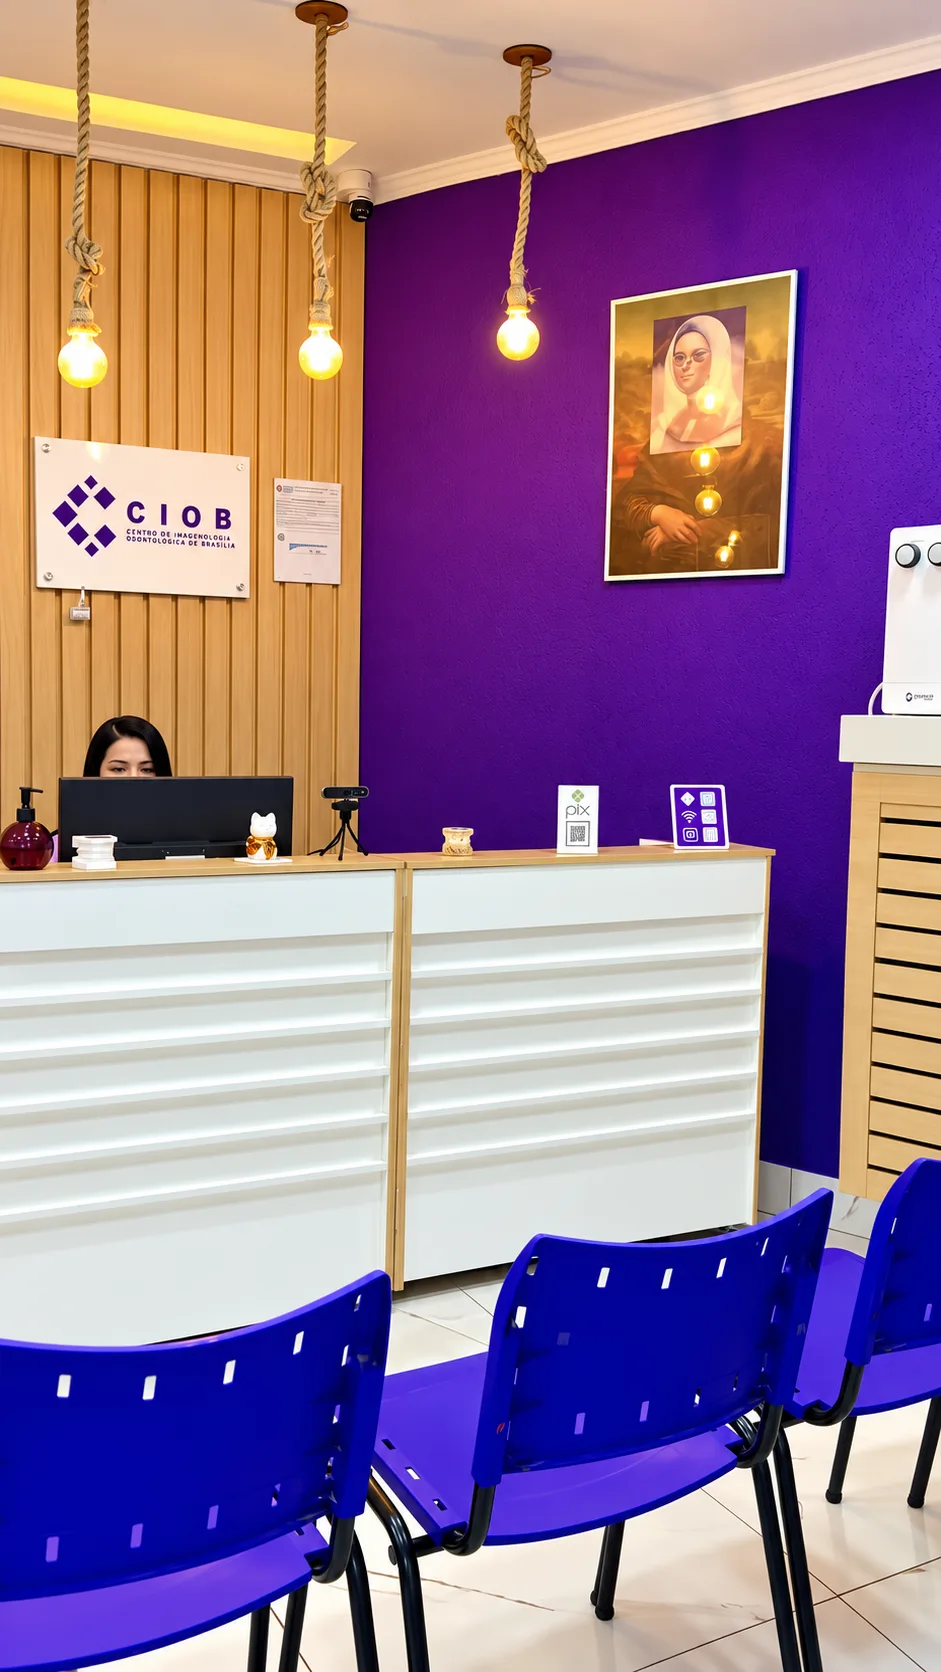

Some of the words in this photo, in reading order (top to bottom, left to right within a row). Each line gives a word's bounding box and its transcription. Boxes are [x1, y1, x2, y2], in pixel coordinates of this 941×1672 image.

[127, 501, 231, 530] CIOB
[126, 528, 157, 537] CENTRO
[174, 532, 231, 541] IMAGENOLOGIA
[565, 803, 590, 819] pix
